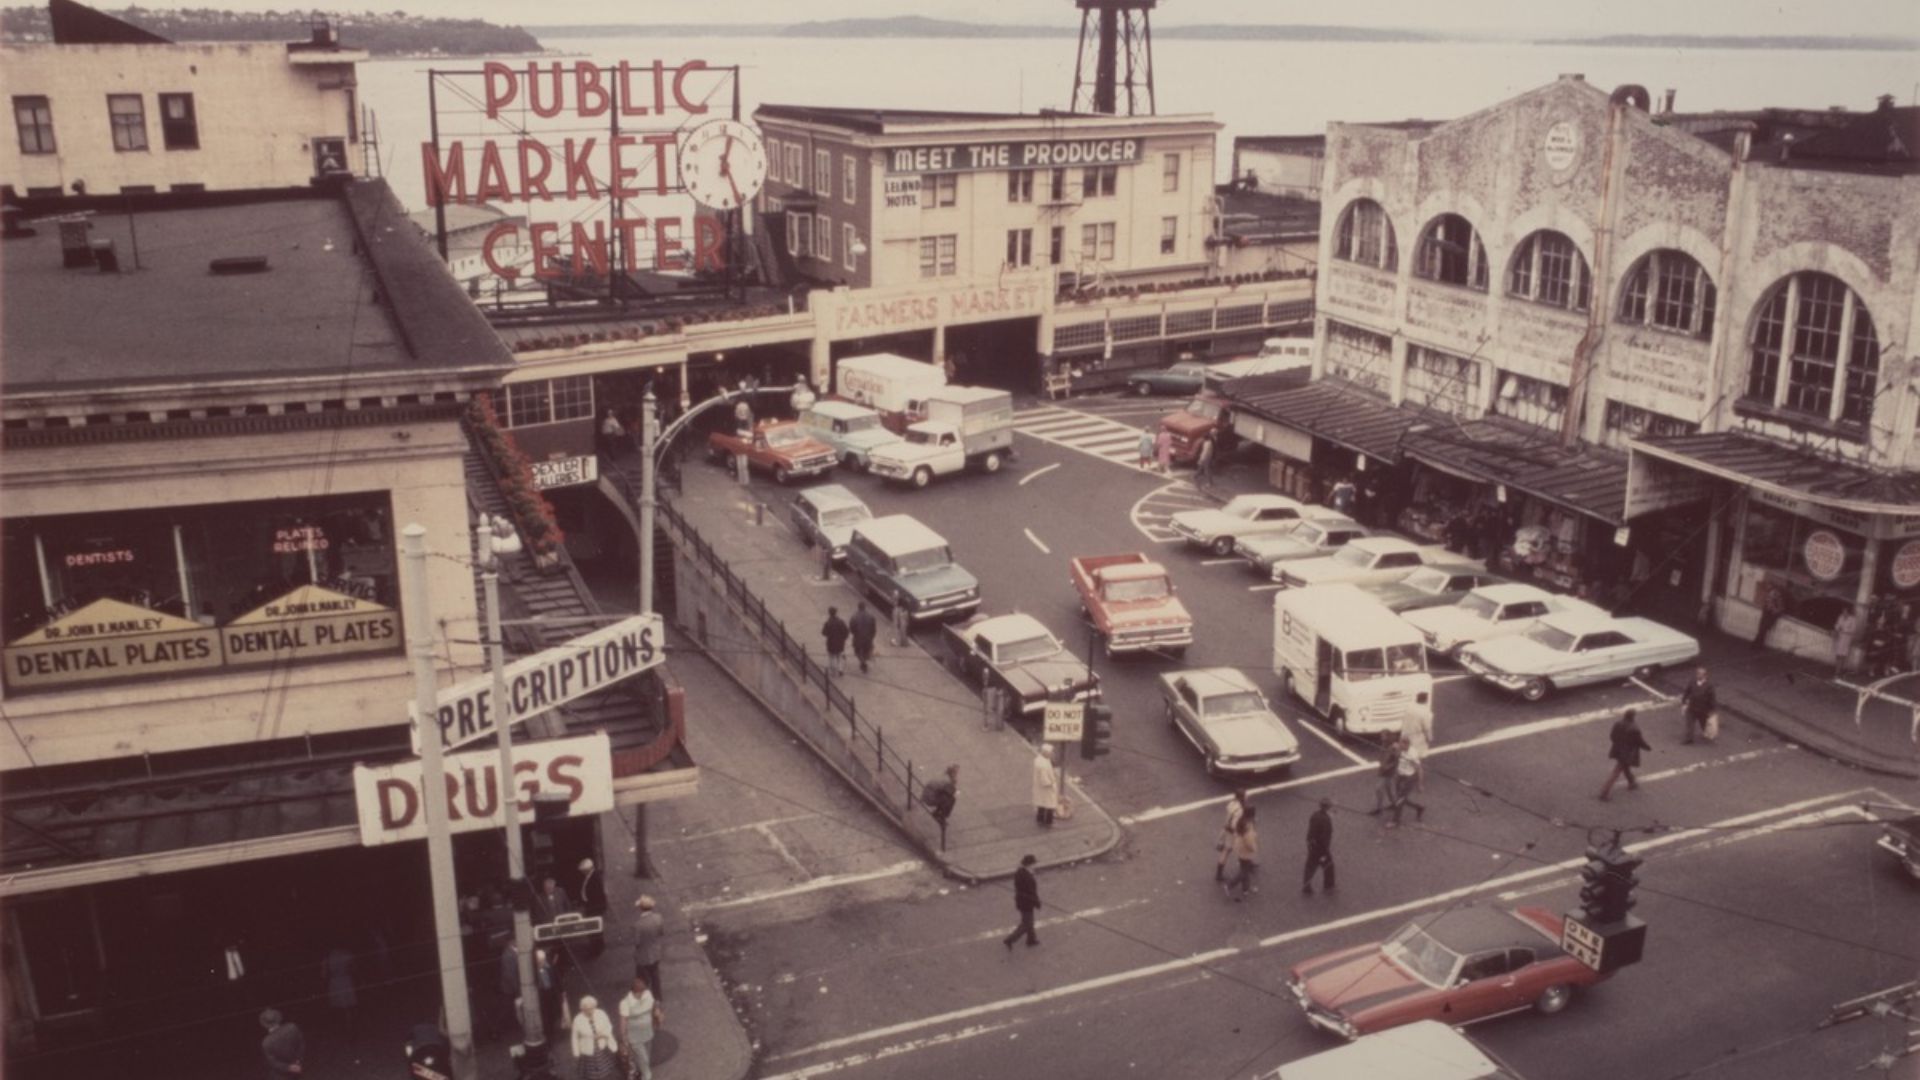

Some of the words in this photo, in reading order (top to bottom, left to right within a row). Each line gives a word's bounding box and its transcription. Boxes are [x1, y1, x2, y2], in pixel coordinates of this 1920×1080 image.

[484, 60, 708, 118] PUBLIC
[421, 135, 678, 207] MARKET
[894, 146, 954, 171] MEET
[968, 144, 1010, 167] THE
[1023, 139, 1137, 165] PRODUCER
[884, 180, 920, 193] LELAND
[886, 195, 917, 208] HOTEL
[482, 216, 727, 280] CENTER
[836, 297, 938, 330] FARMERS
[952, 285, 1039, 317] MARKET
[65, 549, 134, 567] DENTISTS
[230, 627, 307, 655] DENTAL
[316, 617, 394, 646] PLATES
[16, 645, 118, 677] DENTAL
[126, 637, 210, 665] PLATES
[439, 627, 655, 744] PRECRIPTIONS
[1568, 922, 1600, 946] ONE
[1567, 944, 1598, 963] WAY
